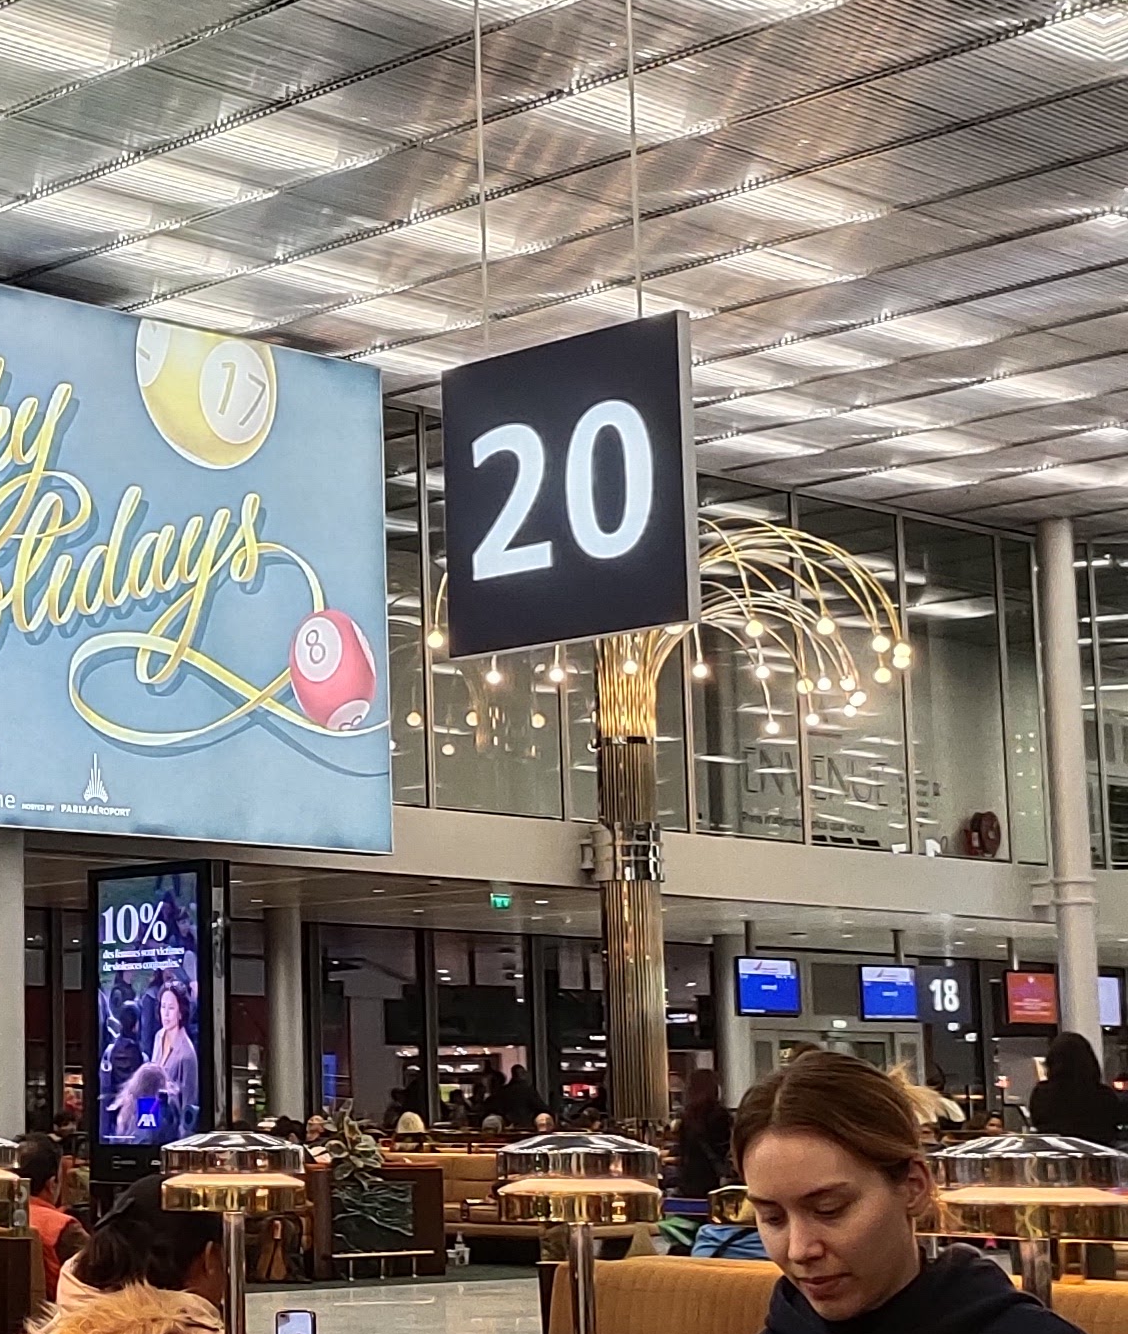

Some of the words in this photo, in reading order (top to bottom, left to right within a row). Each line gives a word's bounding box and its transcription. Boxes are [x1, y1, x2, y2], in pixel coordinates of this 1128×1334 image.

[218, 361, 267, 427] 17
[471, 398, 654, 582] 20
[305, 629, 327, 665] 8
[102, 901, 168, 946] 10%
[928, 978, 960, 1013] 18
